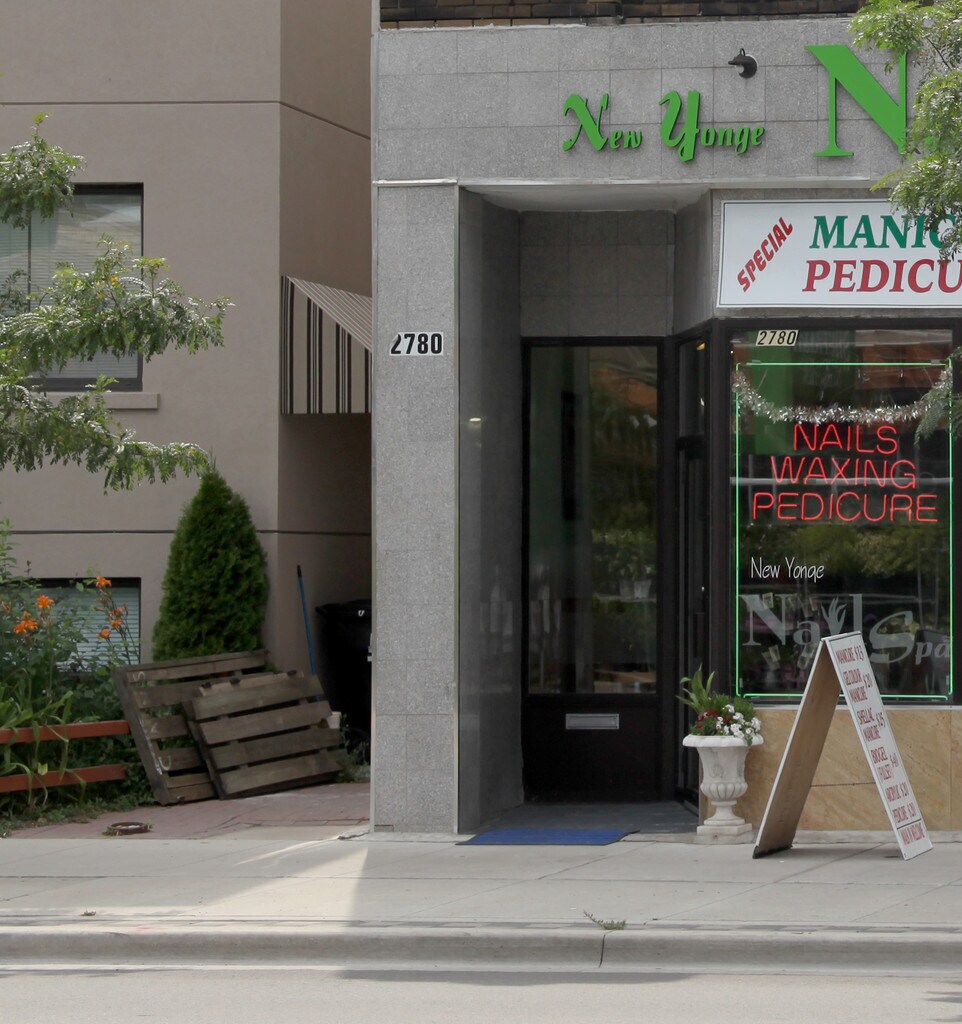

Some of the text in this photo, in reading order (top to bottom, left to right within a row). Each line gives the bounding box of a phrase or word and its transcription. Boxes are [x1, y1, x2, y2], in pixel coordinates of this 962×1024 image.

[562, 93, 643, 152] New
[659, 89, 765, 162] Yonge
[737, 216, 794, 293] SPECIAL
[390, 332, 443, 355] 2780
[757, 331, 796, 346] 2780
[793, 423, 898, 455] NAILS
[770, 455, 917, 489] WAXING
[752, 491, 938, 523] PEDICURE
[751, 556, 780, 579] New
